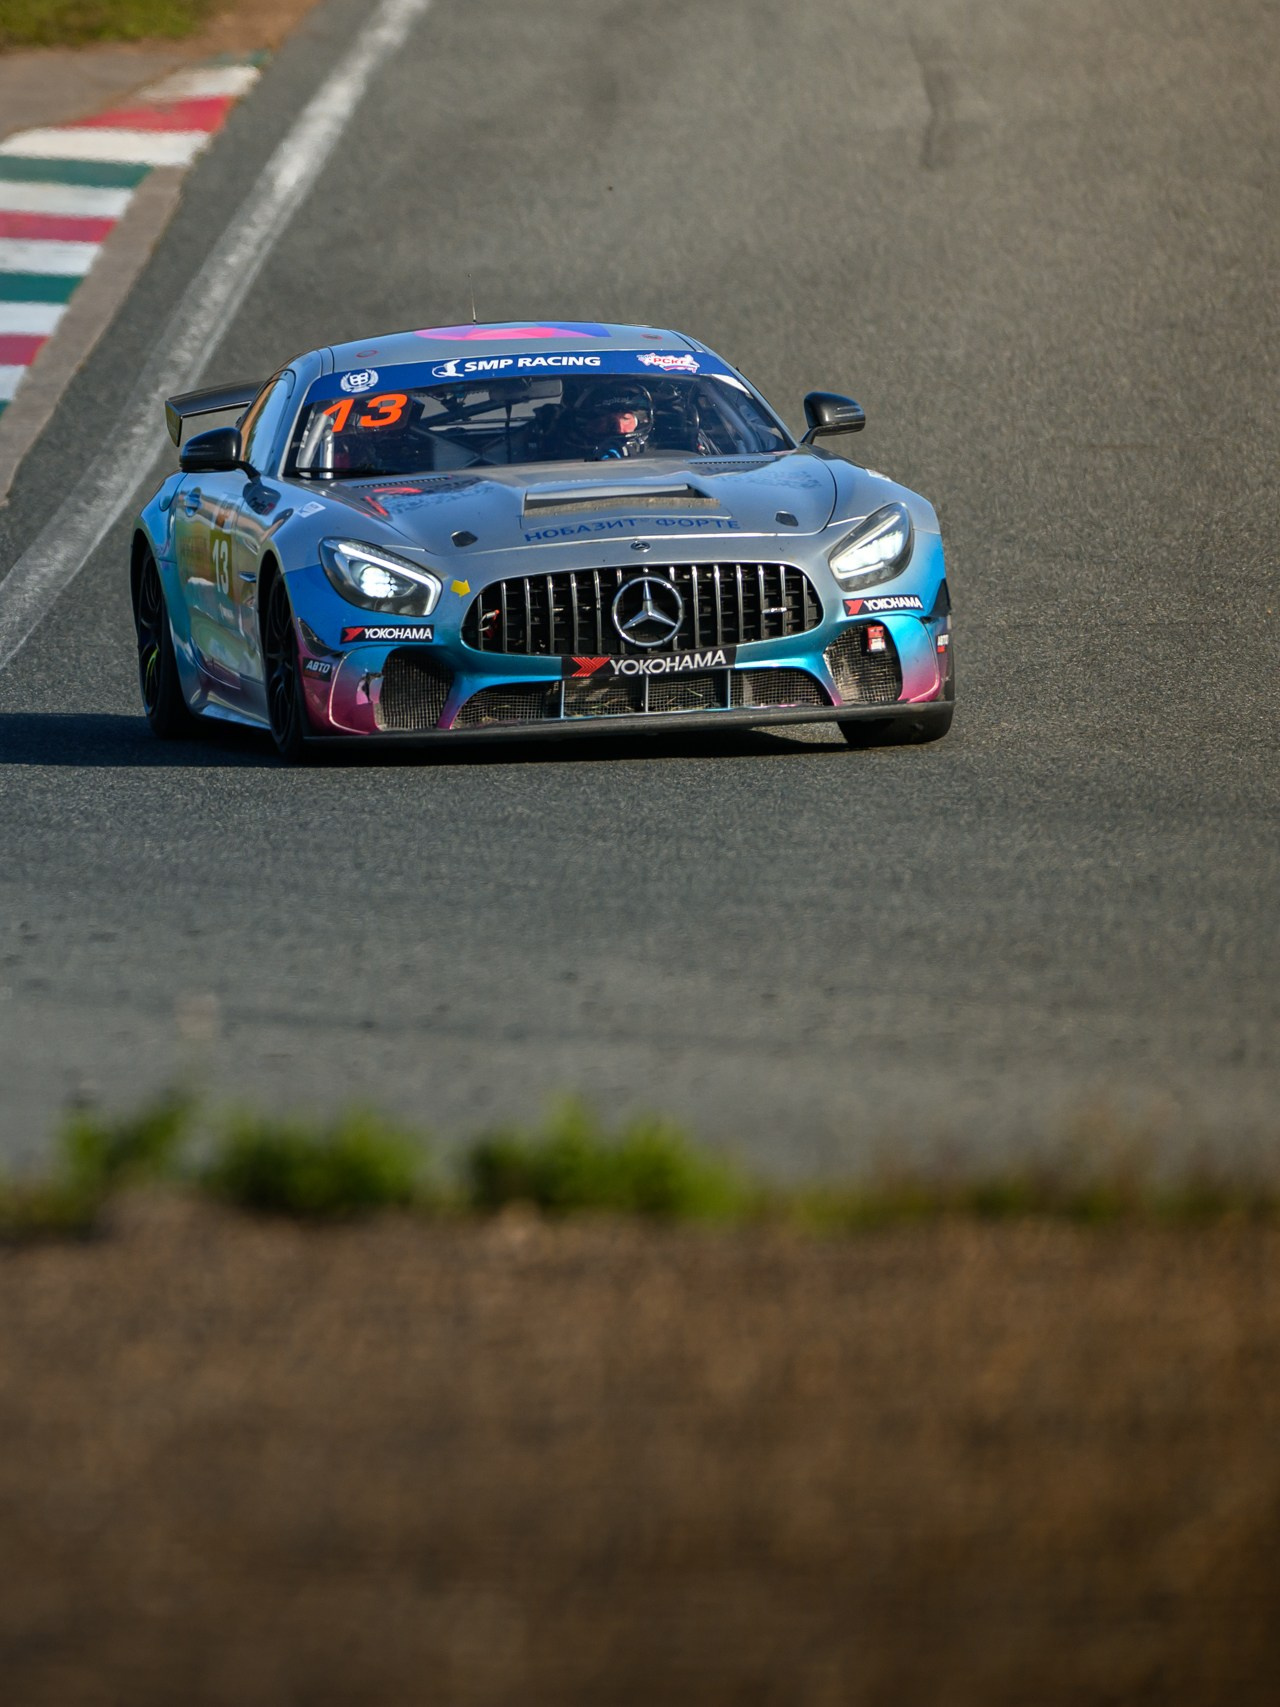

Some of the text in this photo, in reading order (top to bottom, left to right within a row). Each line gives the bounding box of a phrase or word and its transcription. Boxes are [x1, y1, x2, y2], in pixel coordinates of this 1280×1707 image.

[464, 357, 601, 372] SMP RACING
[323, 393, 408, 432] 13
[524, 518, 741, 542] НОБАЗИТ ФОРТЕ
[213, 539, 228, 596] 13
[864, 597, 923, 611] YOKOHAMA
[364, 627, 433, 640] YOKOHAMA
[306, 659, 331, 674] АВТО
[609, 649, 727, 675] YOKOHAMA
